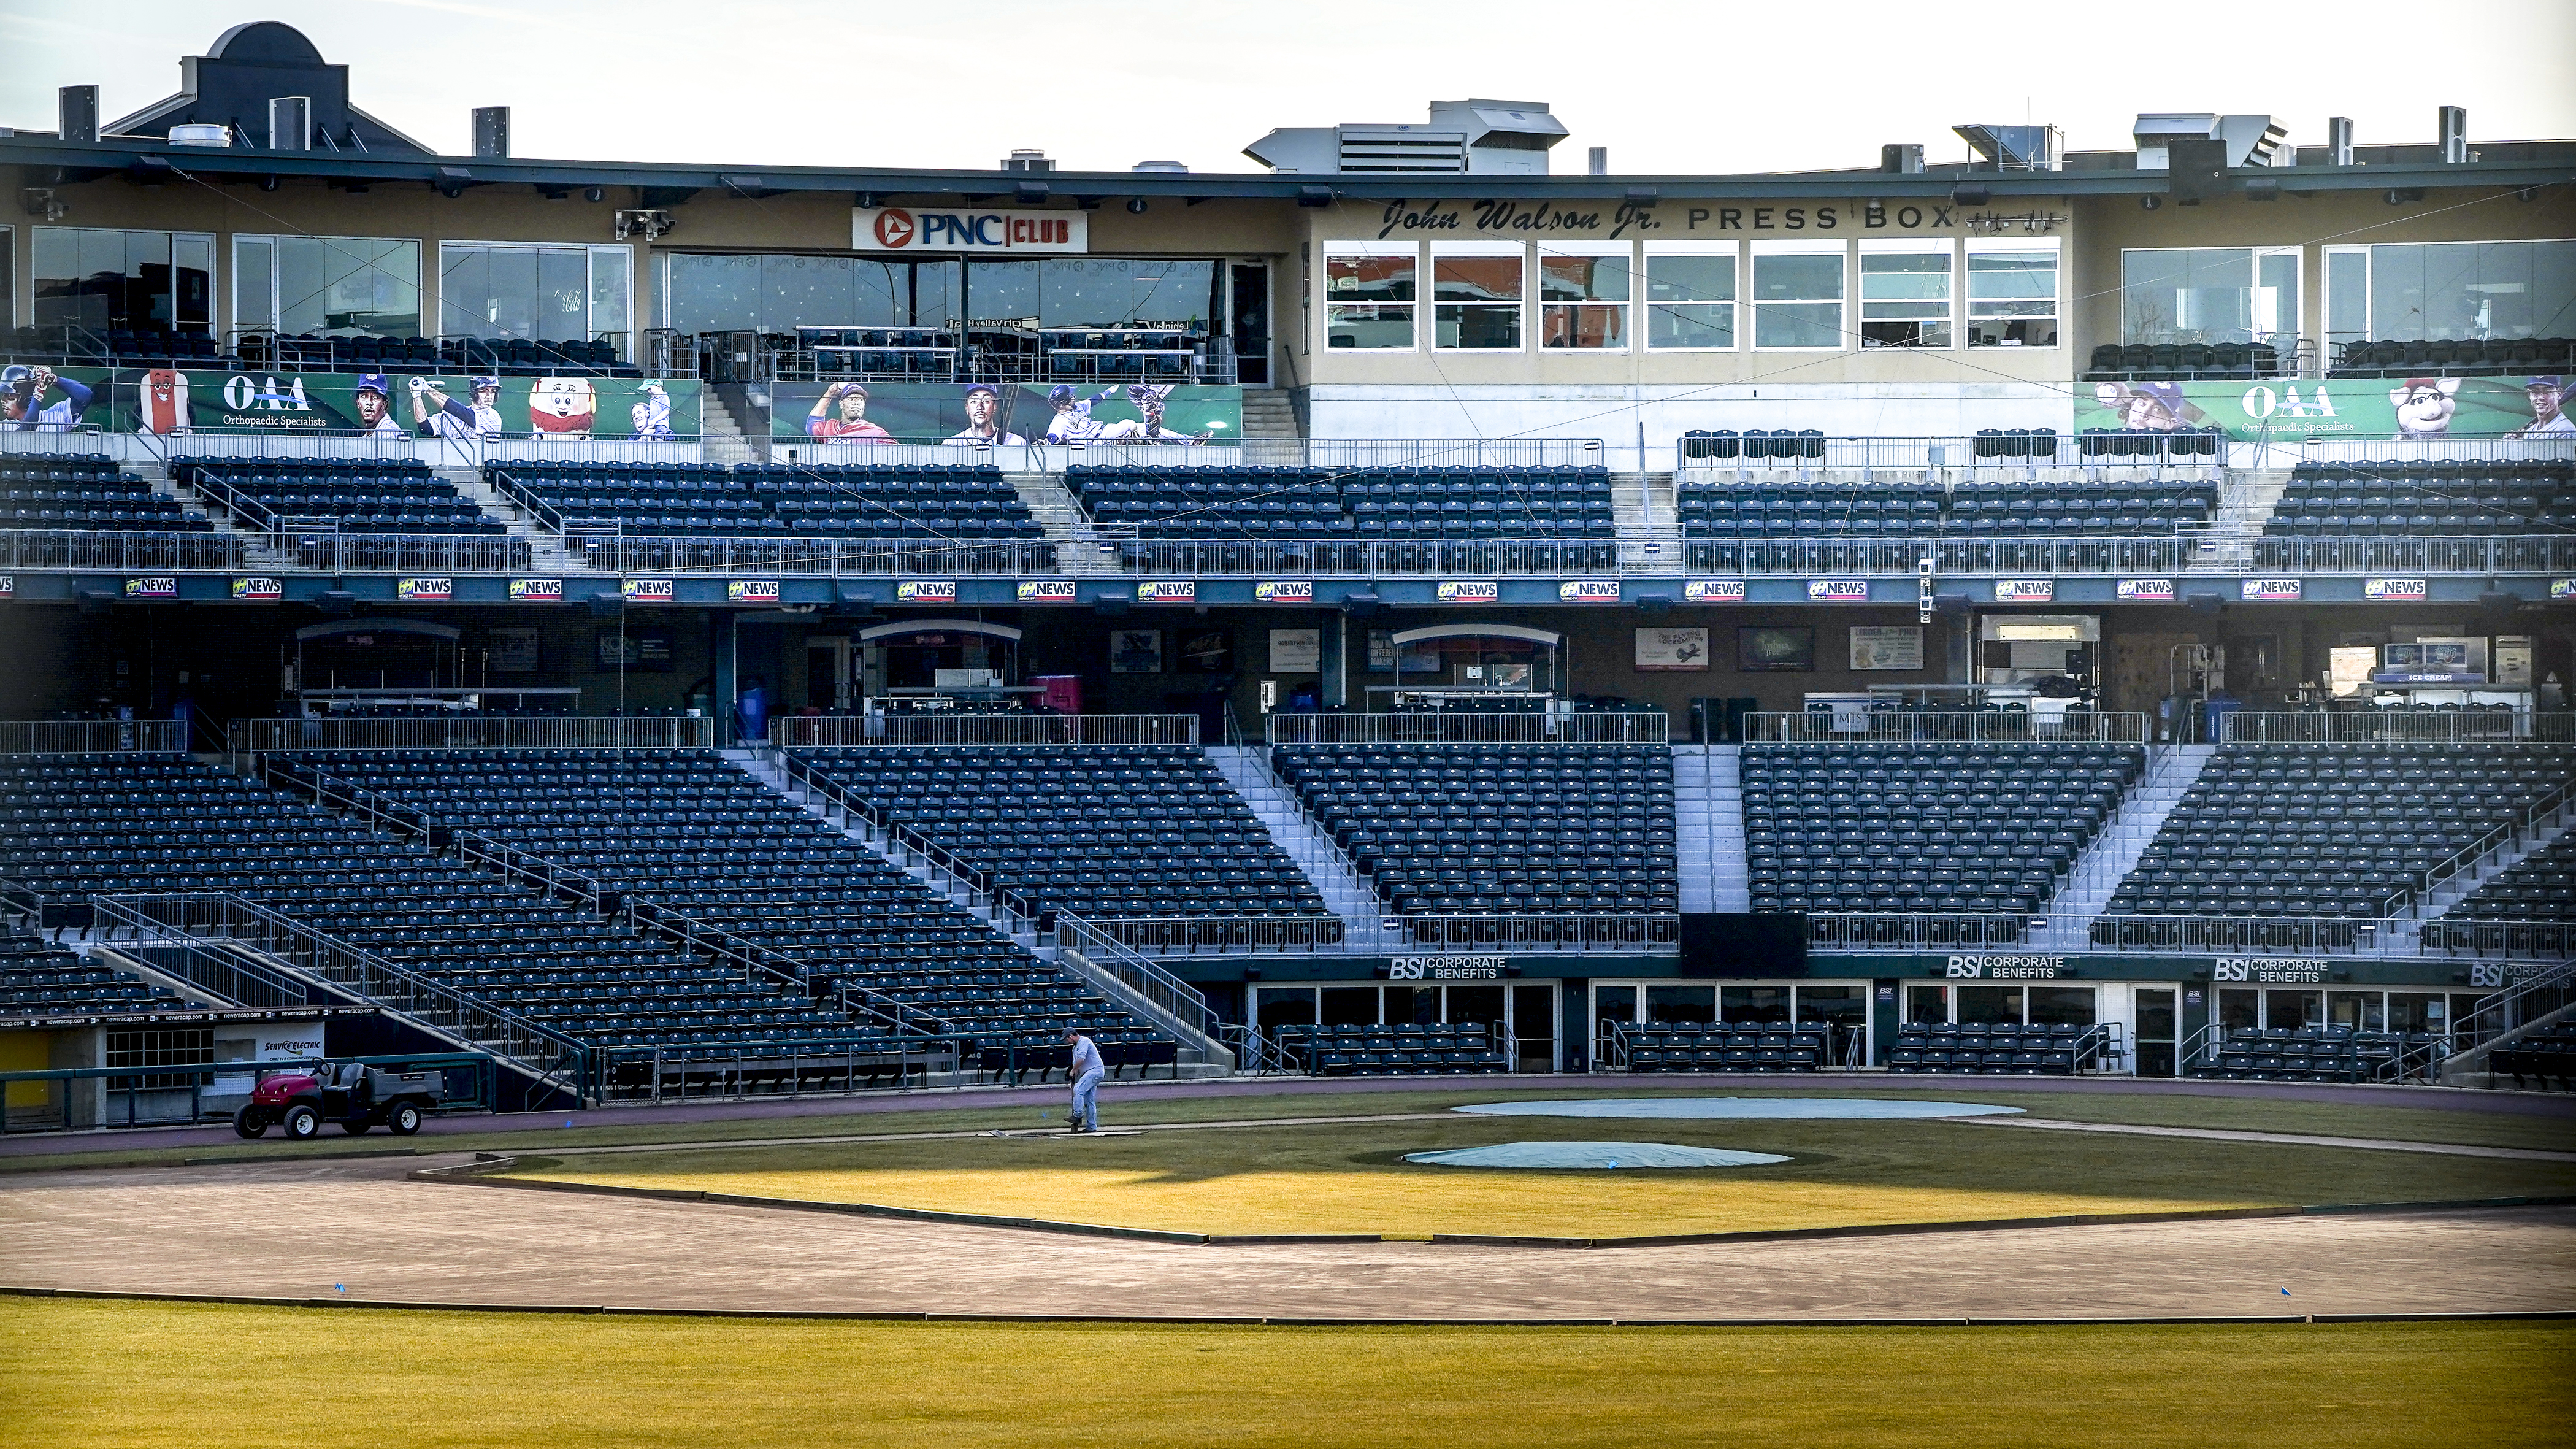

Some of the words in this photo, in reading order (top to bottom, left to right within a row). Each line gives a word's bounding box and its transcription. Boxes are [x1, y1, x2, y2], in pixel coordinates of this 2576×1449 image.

[1378, 199, 1460, 239] John
[1473, 199, 1600, 231] Walson
[1609, 199, 1660, 239] Jr.
[1688, 207, 1837, 229] PRESS
[1864, 206, 1954, 229] BOX
[918, 214, 1002, 246] PNC
[1014, 219, 1068, 244] CLUB
[224, 375, 313, 411] OAA
[2242, 385, 2339, 418] OAA
[223, 415, 278, 427] Orthopaedic
[280, 415, 326, 428] Specialists
[2241, 423, 2302, 434] Orthopaedic
[2304, 421, 2355, 433] Specialists
[142, 579, 174, 591] NEWS
[232, 577, 247, 594] 69
[247, 580, 281, 592] NEWS
[398, 578, 413, 594] 69
[415, 580, 450, 593] NEWS
[510, 579, 525, 595] 69
[526, 581, 561, 594] NEWS
[637, 582, 671, 594] NEWS
[729, 580, 743, 596] 69
[744, 583, 778, 594] NEWS
[897, 581, 916, 597] 69
[916, 583, 954, 595] NEWS
[1018, 581, 1035, 597] 69
[1036, 583, 1074, 595] NEWS
[1138, 582, 1155, 597] 69
[1156, 583, 1194, 596] NEWS
[1255, 581, 1273, 597] 69
[1274, 583, 1311, 596] NEWS
[1438, 582, 1455, 597] 69
[1457, 584, 1496, 596] NEWS
[1560, 581, 1578, 597] 69
[1579, 583, 1618, 595] NEWS
[1685, 581, 1703, 597] 69
[1704, 583, 1744, 595] NEWS
[1809, 580, 1827, 596] 69
[1828, 583, 1865, 594] NEWS
[1995, 580, 2014, 596] 69
[2014, 582, 2052, 594] NEWS
[2117, 580, 2135, 595] 69
[2136, 582, 2172, 593] NEWS
[2243, 580, 2260, 594] 69
[2261, 582, 2299, 593] NEWS
[2365, 579, 2383, 595] 69
[2385, 582, 2424, 593] NEWS
[2551, 579, 2568, 594] 69
[1389, 958, 1426, 980] BSI
[1427, 958, 1505, 968] CORPORATE
[1435, 969, 1497, 979] BENEFITS
[1945, 956, 1984, 978] BSI
[1984, 957, 2063, 967] CORPORATE
[1993, 968, 2055, 978] BENEFITS
[2214, 959, 2250, 982] BSI
[2250, 960, 2328, 971] CORPORATE
[2259, 972, 2320, 982] BENEFITS
[2470, 964, 2504, 987] BSI
